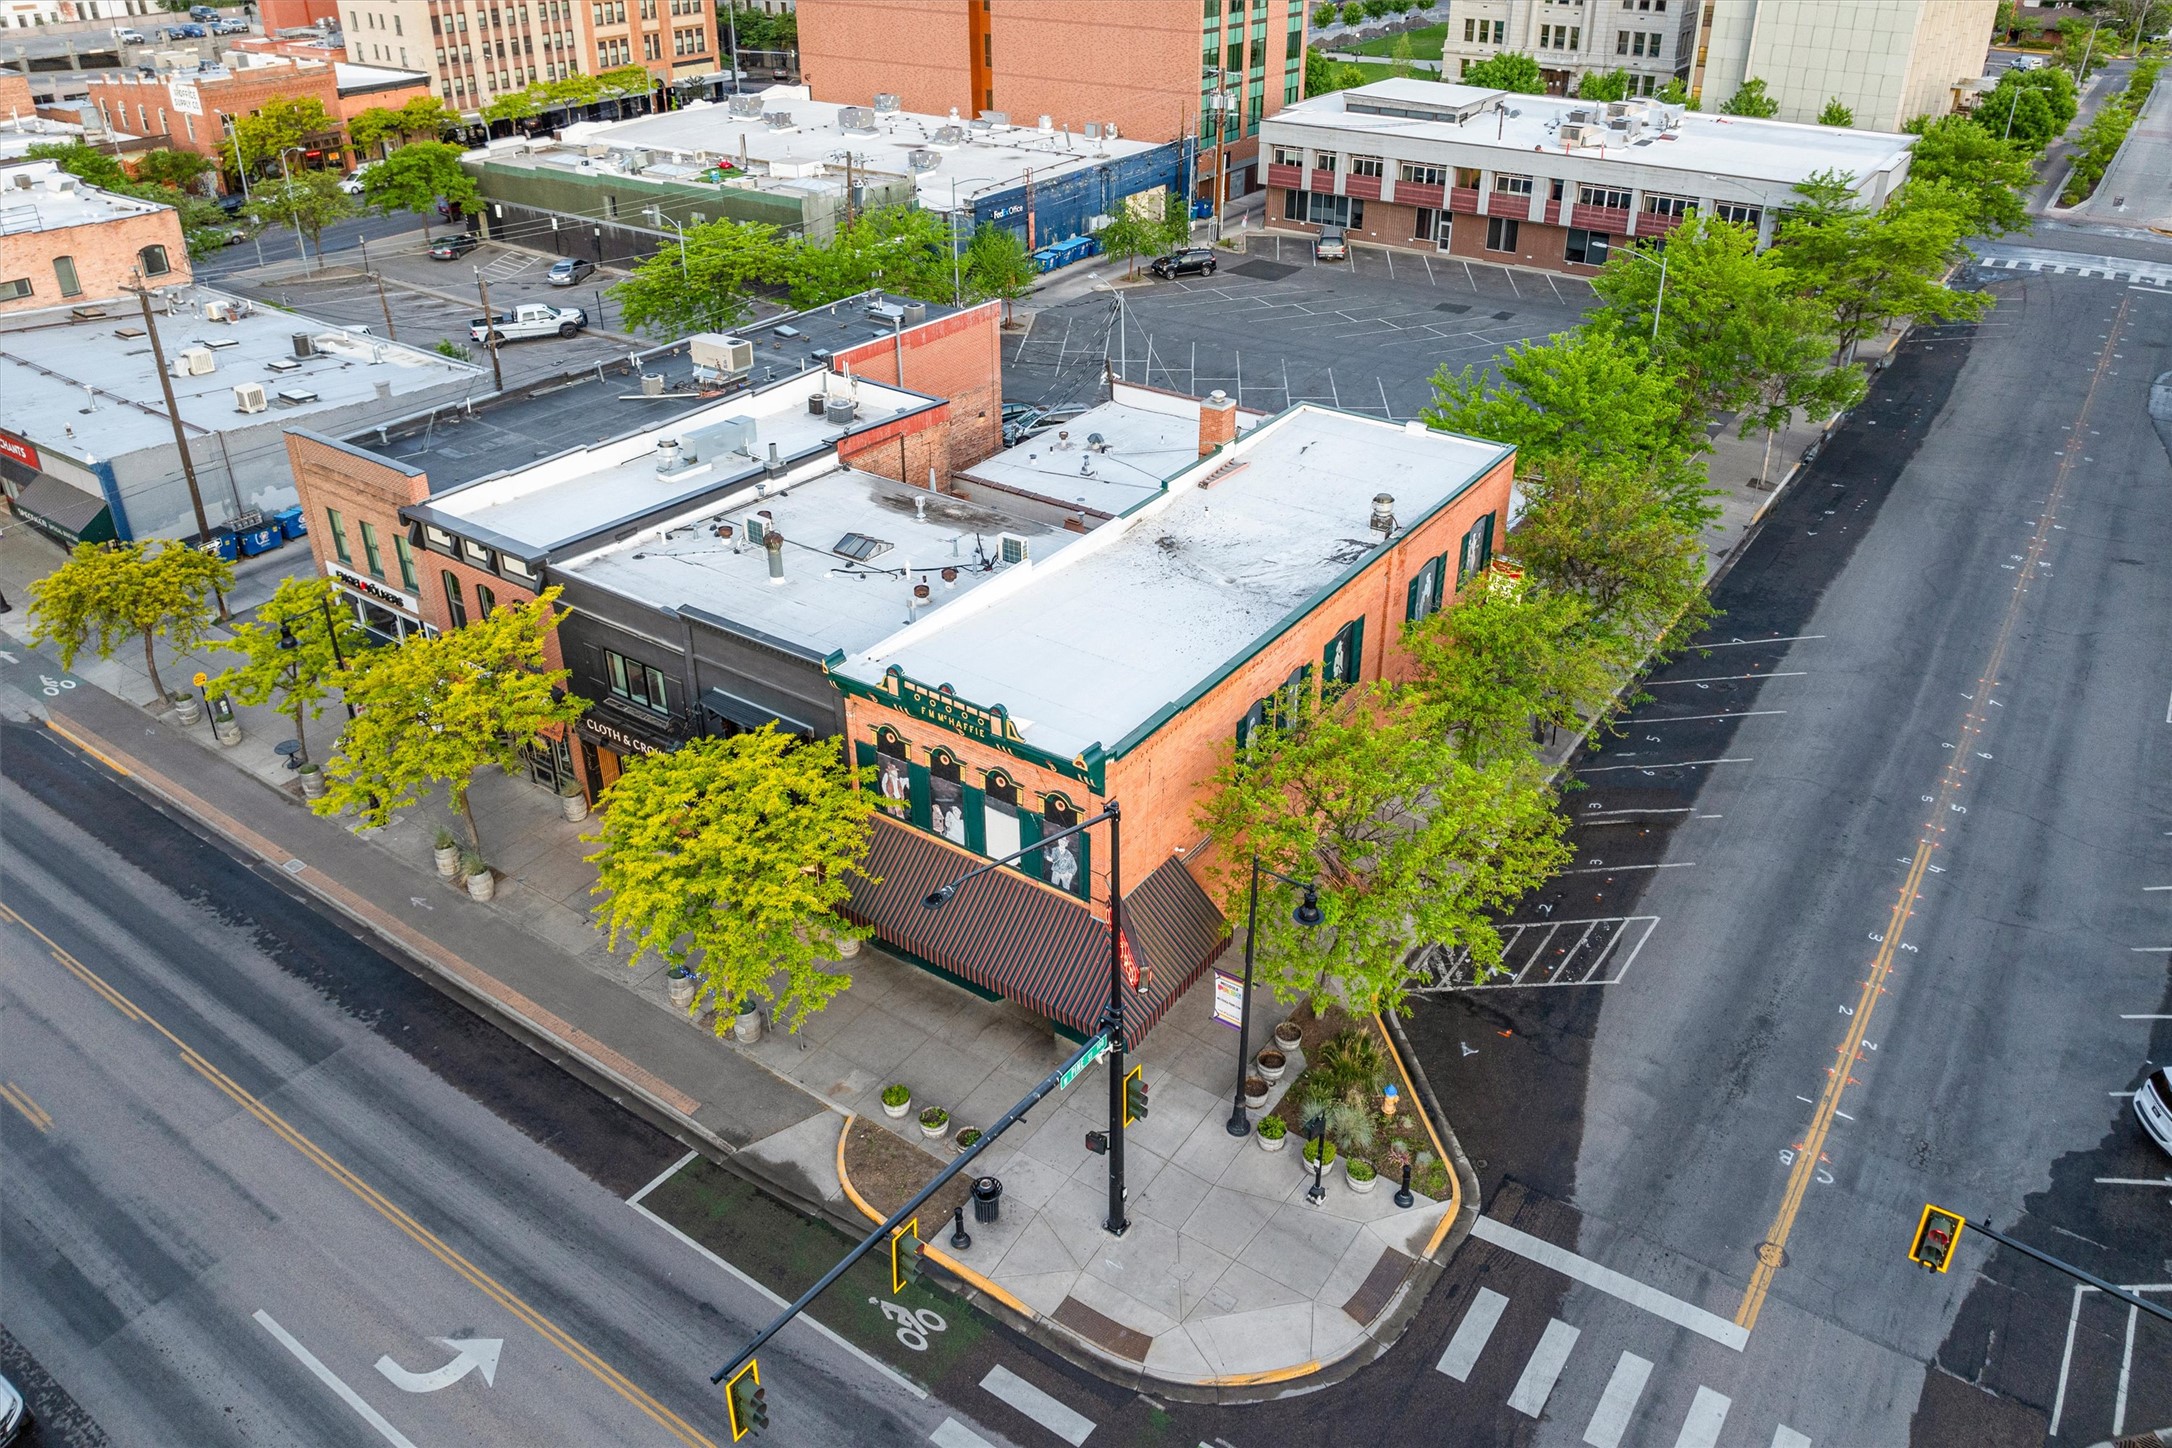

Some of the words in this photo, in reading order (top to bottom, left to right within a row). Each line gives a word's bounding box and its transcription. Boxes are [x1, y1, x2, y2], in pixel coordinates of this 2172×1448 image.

[586, 719, 621, 742] CLOTH
[623, 735, 631, 747] &
[1071, 1060, 1084, 1077] PINE
